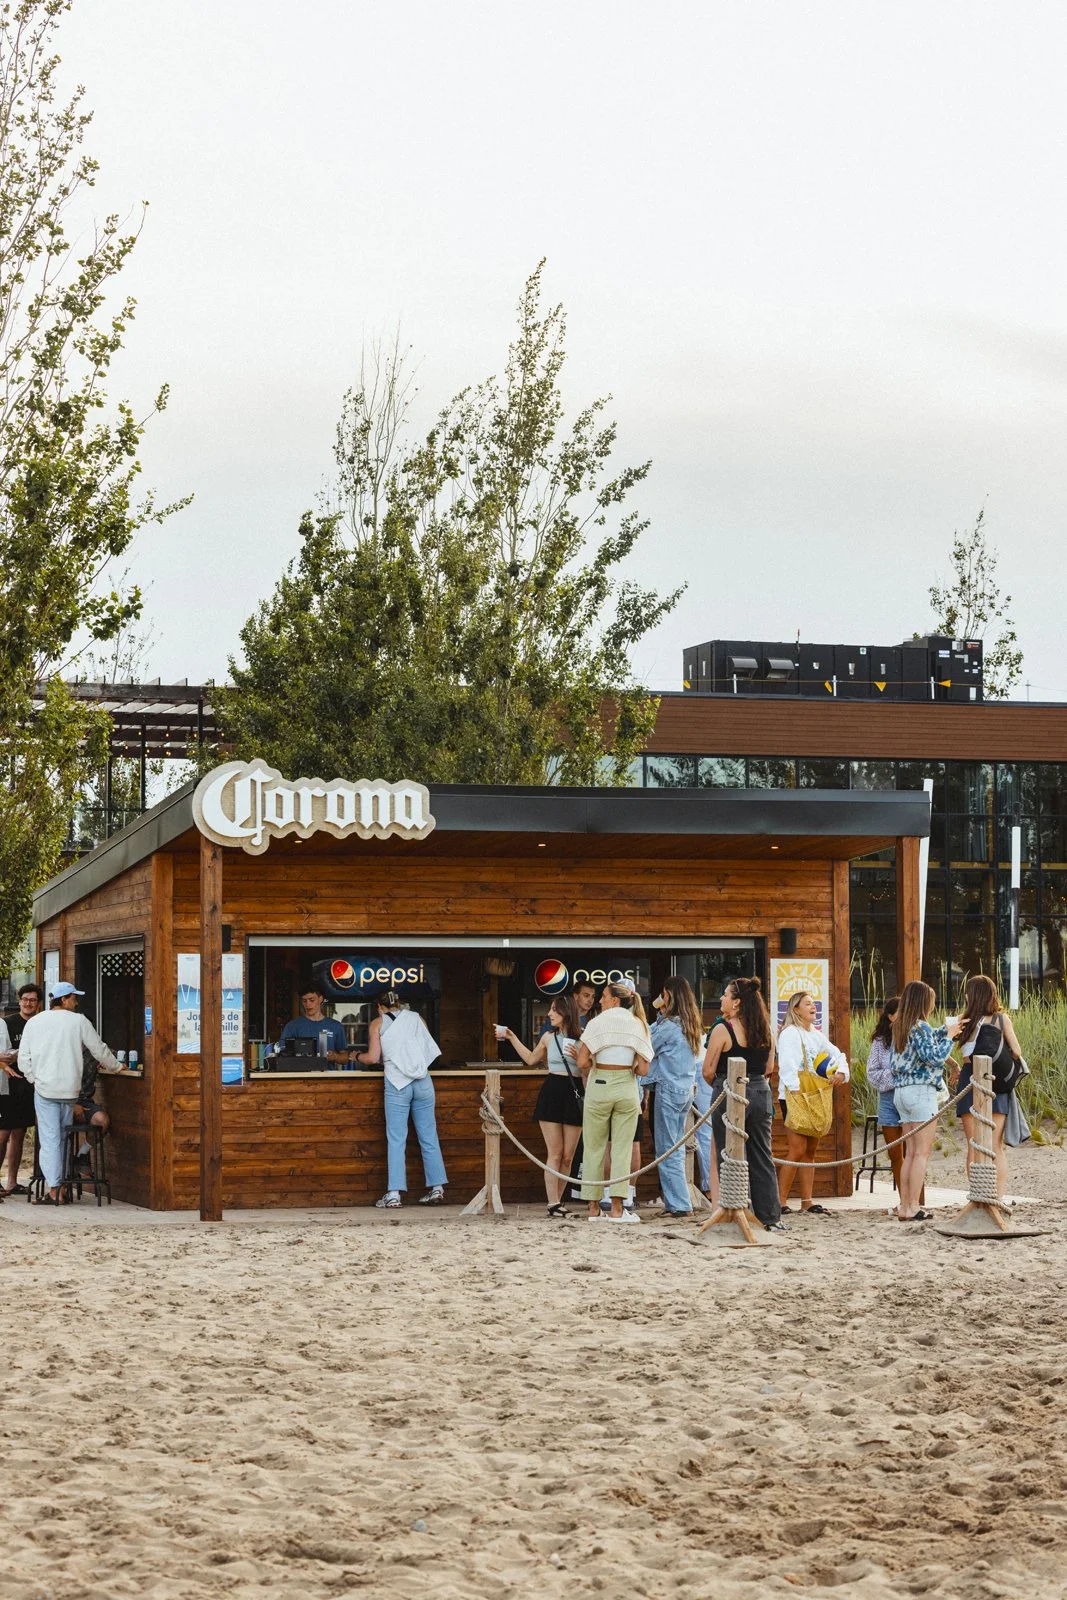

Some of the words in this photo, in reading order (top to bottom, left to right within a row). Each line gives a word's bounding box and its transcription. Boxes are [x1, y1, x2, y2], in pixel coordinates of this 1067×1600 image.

[202, 768, 428, 846] Corona
[360, 963, 424, 988] pepsi
[227, 1012, 239, 1021] de
